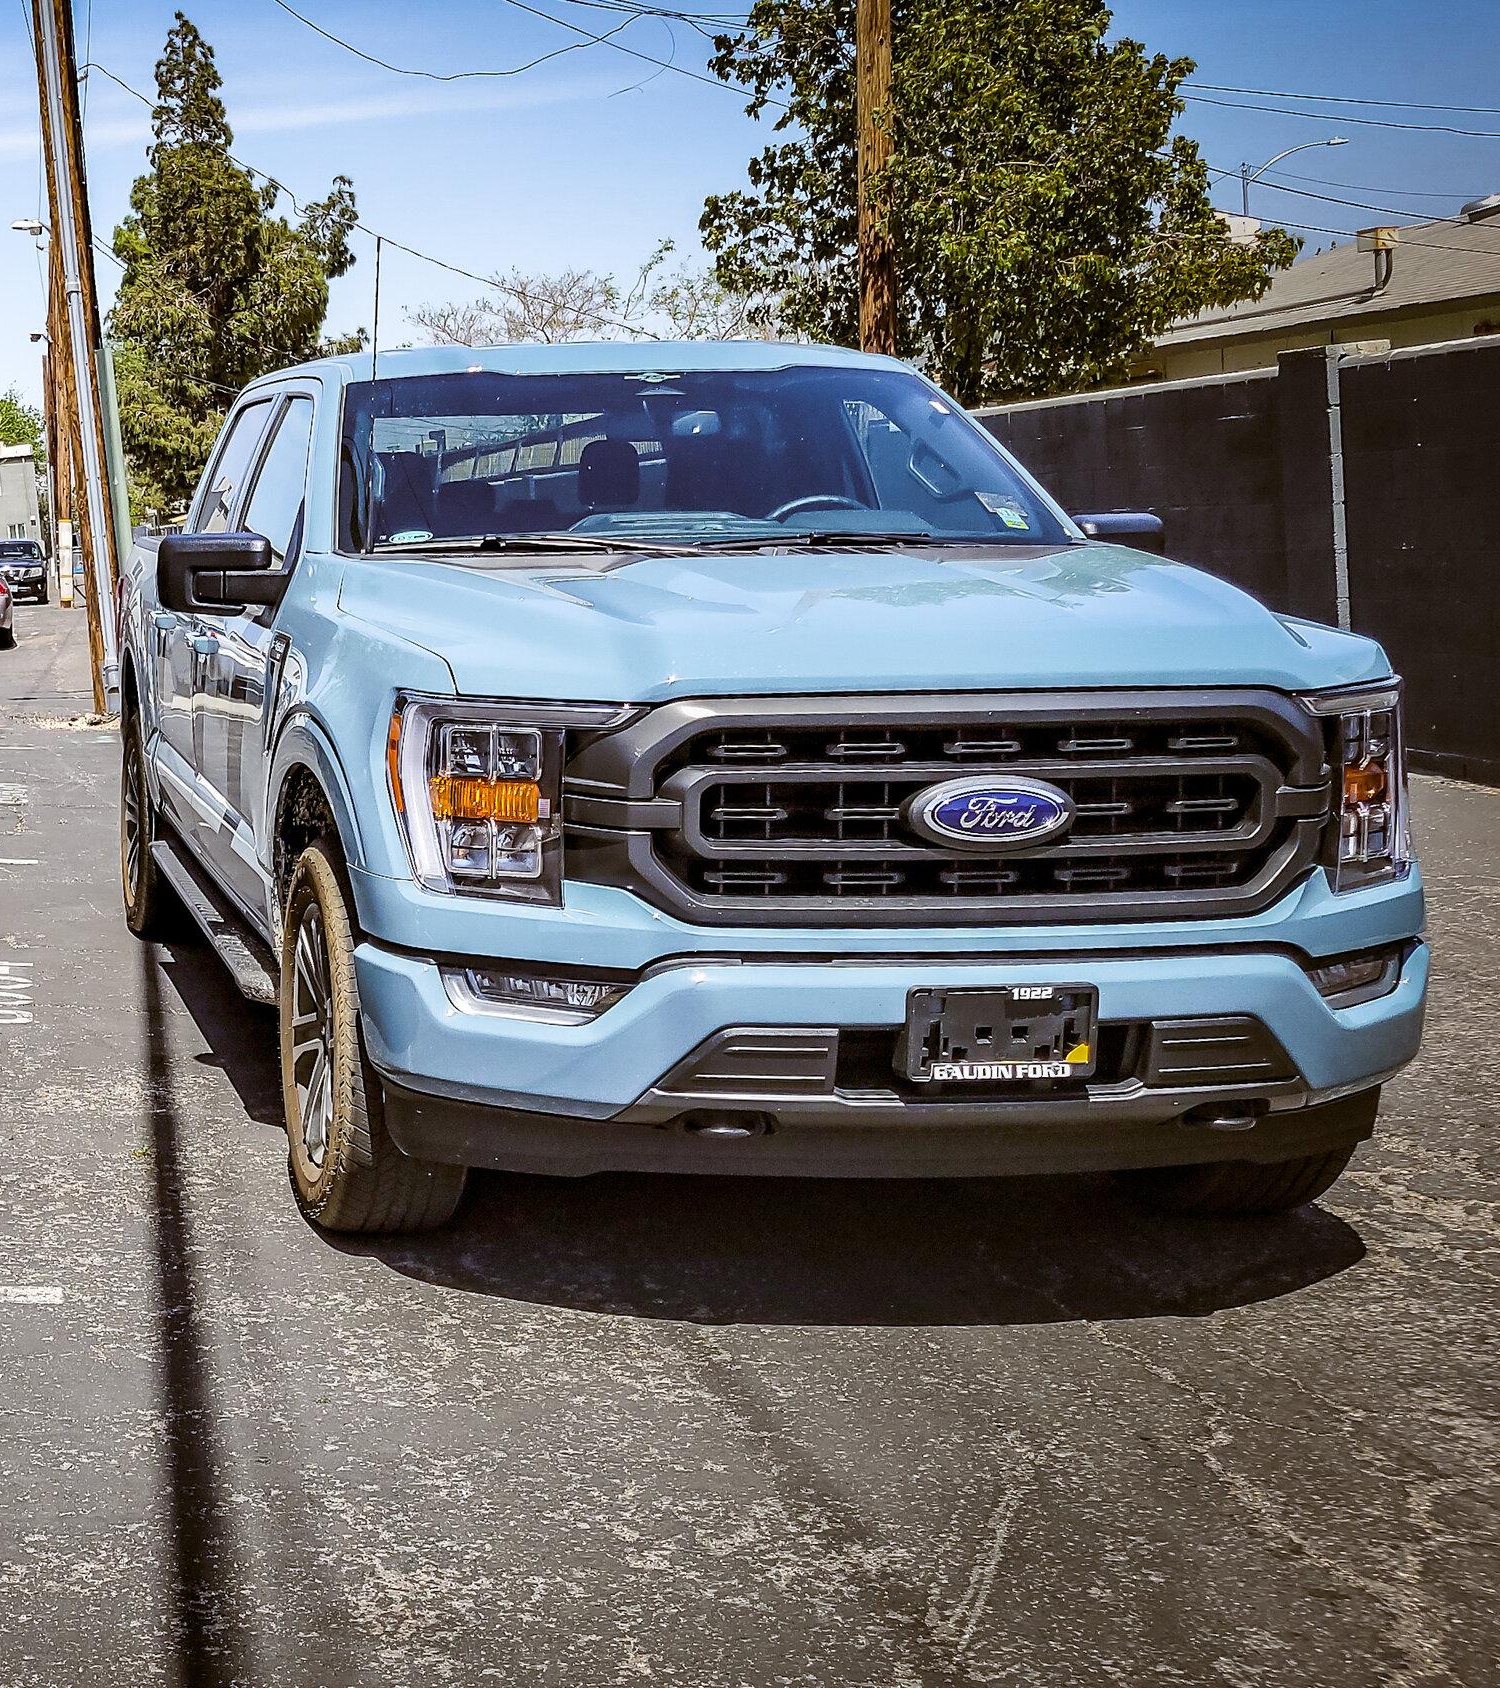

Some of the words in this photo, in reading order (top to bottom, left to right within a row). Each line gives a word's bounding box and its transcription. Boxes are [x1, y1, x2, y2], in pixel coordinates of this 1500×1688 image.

[960, 797, 1036, 829] Ford
[1012, 986, 1053, 1001] 1922
[1016, 1063, 1071, 1079] FORD
